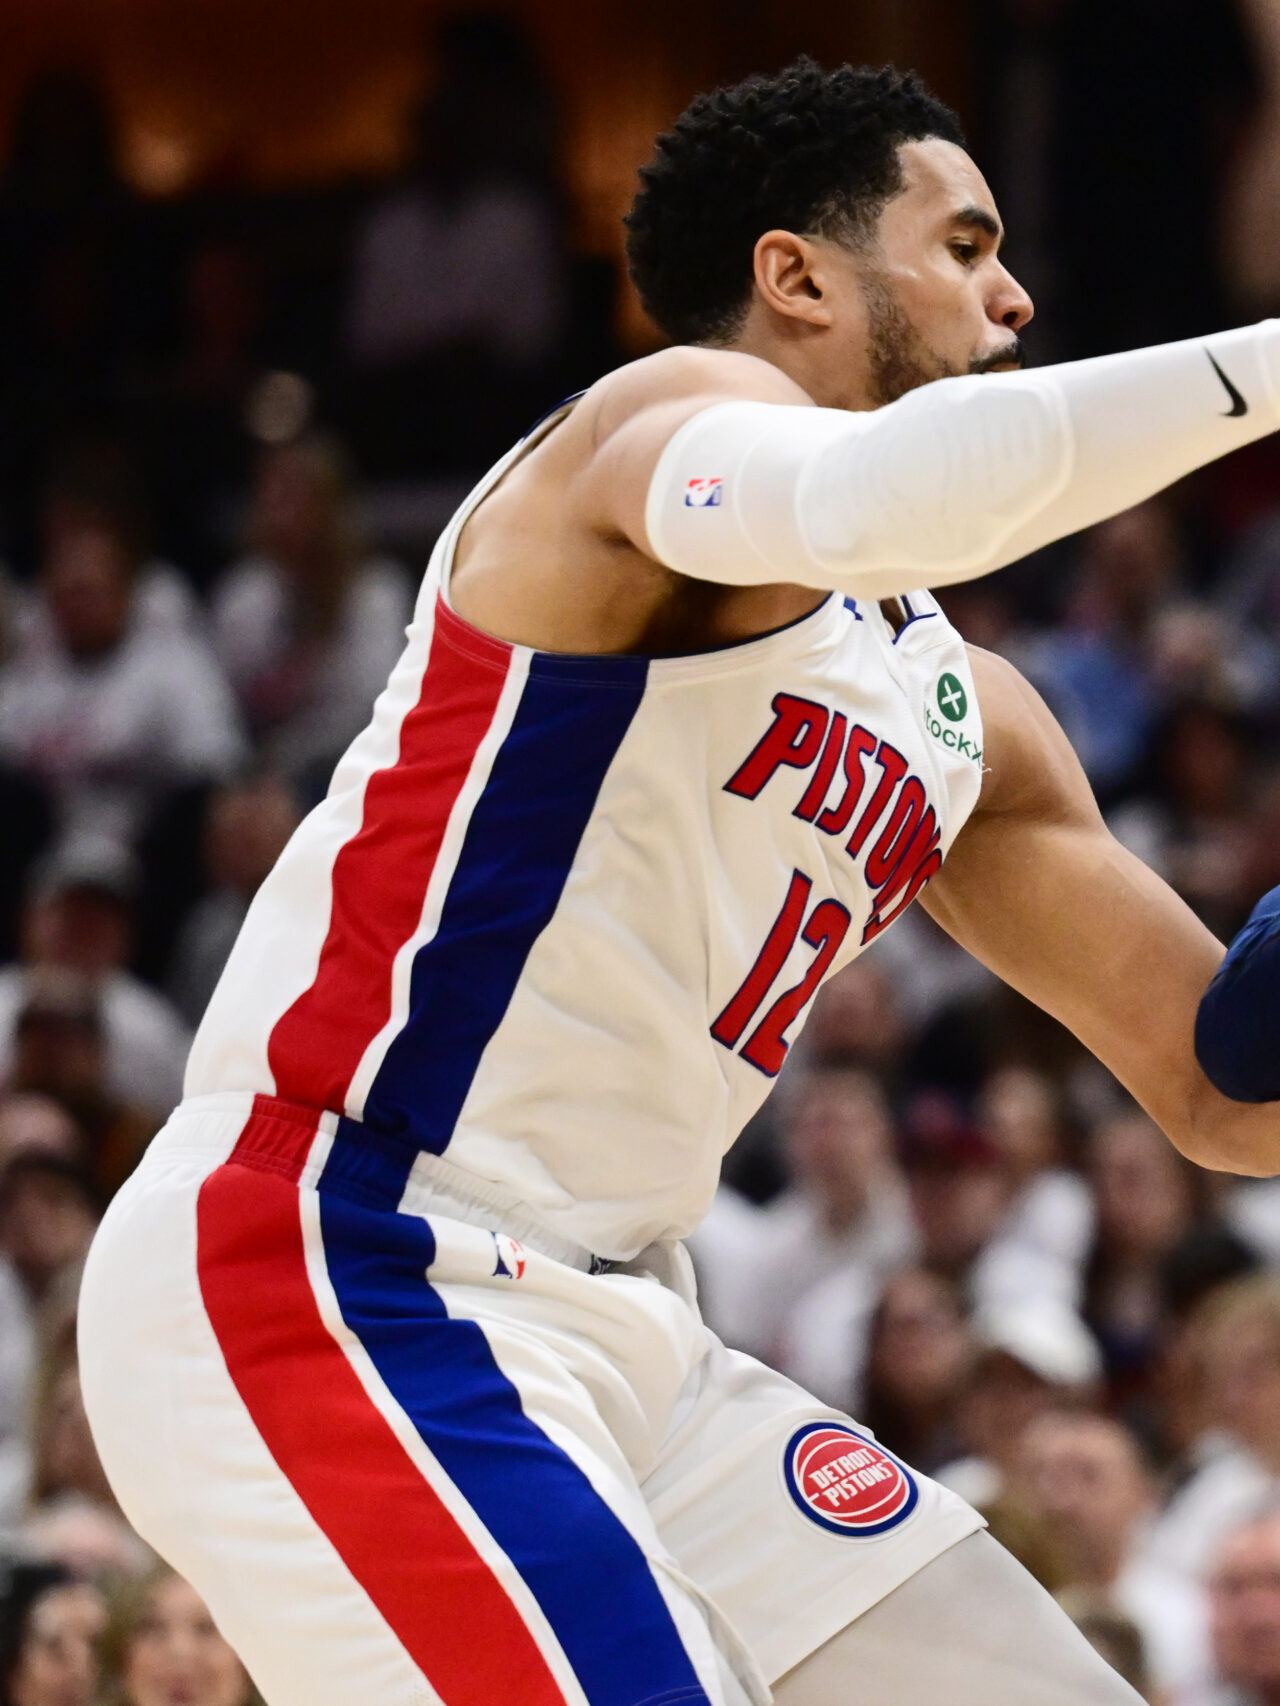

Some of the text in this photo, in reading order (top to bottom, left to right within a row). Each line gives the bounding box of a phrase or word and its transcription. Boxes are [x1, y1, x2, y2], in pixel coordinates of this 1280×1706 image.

[722, 692, 943, 947] PISTONS
[710, 868, 851, 1078] 12
[808, 1447, 878, 1490] DETROIT
[821, 1462, 894, 1508] PISTONS
